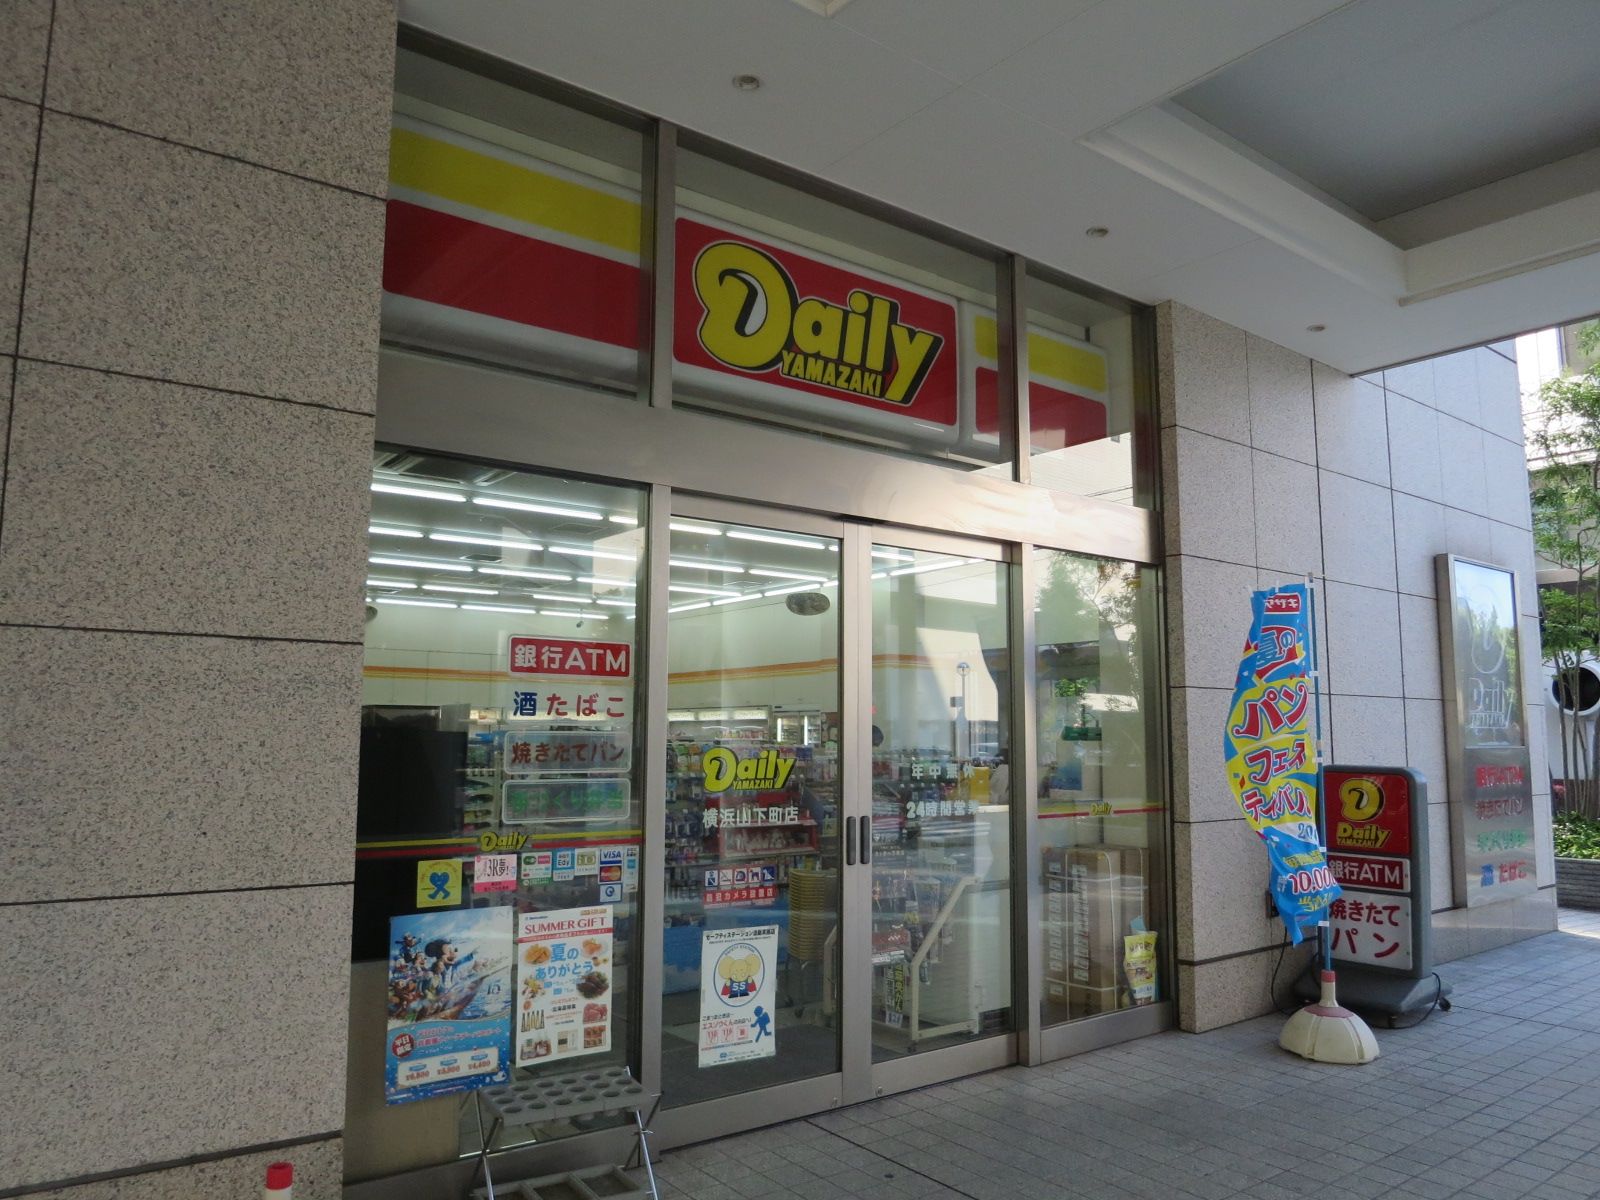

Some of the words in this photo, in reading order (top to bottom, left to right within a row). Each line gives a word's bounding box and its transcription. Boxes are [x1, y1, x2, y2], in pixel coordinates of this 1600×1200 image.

[692, 240, 944, 406] Daily
[782, 349, 884, 398] YAMAZAKI
[514, 644, 627, 673] 銀行ATM
[1232, 682, 1310, 741] パン
[703, 747, 797, 793] Daily
[1246, 740, 1307, 784] フェス
[733, 780, 774, 790] YAMAZAKI
[703, 806, 799, 829] 横浜山下町店
[480, 831, 528, 852] Daily
[1336, 822, 1391, 847] Daily
[603, 851, 621, 859] VISA
[1328, 859, 1400, 885] 銀行ATM
[525, 920, 575, 935] SUMMER
[577, 916, 608, 929] GIFT
[1328, 899, 1400, 927] 焼きたて
[551, 943, 580, 963] 夏の
[1331, 927, 1400, 958] パン
[535, 960, 593, 980] ありがとう
[732, 982, 746, 991] SS
